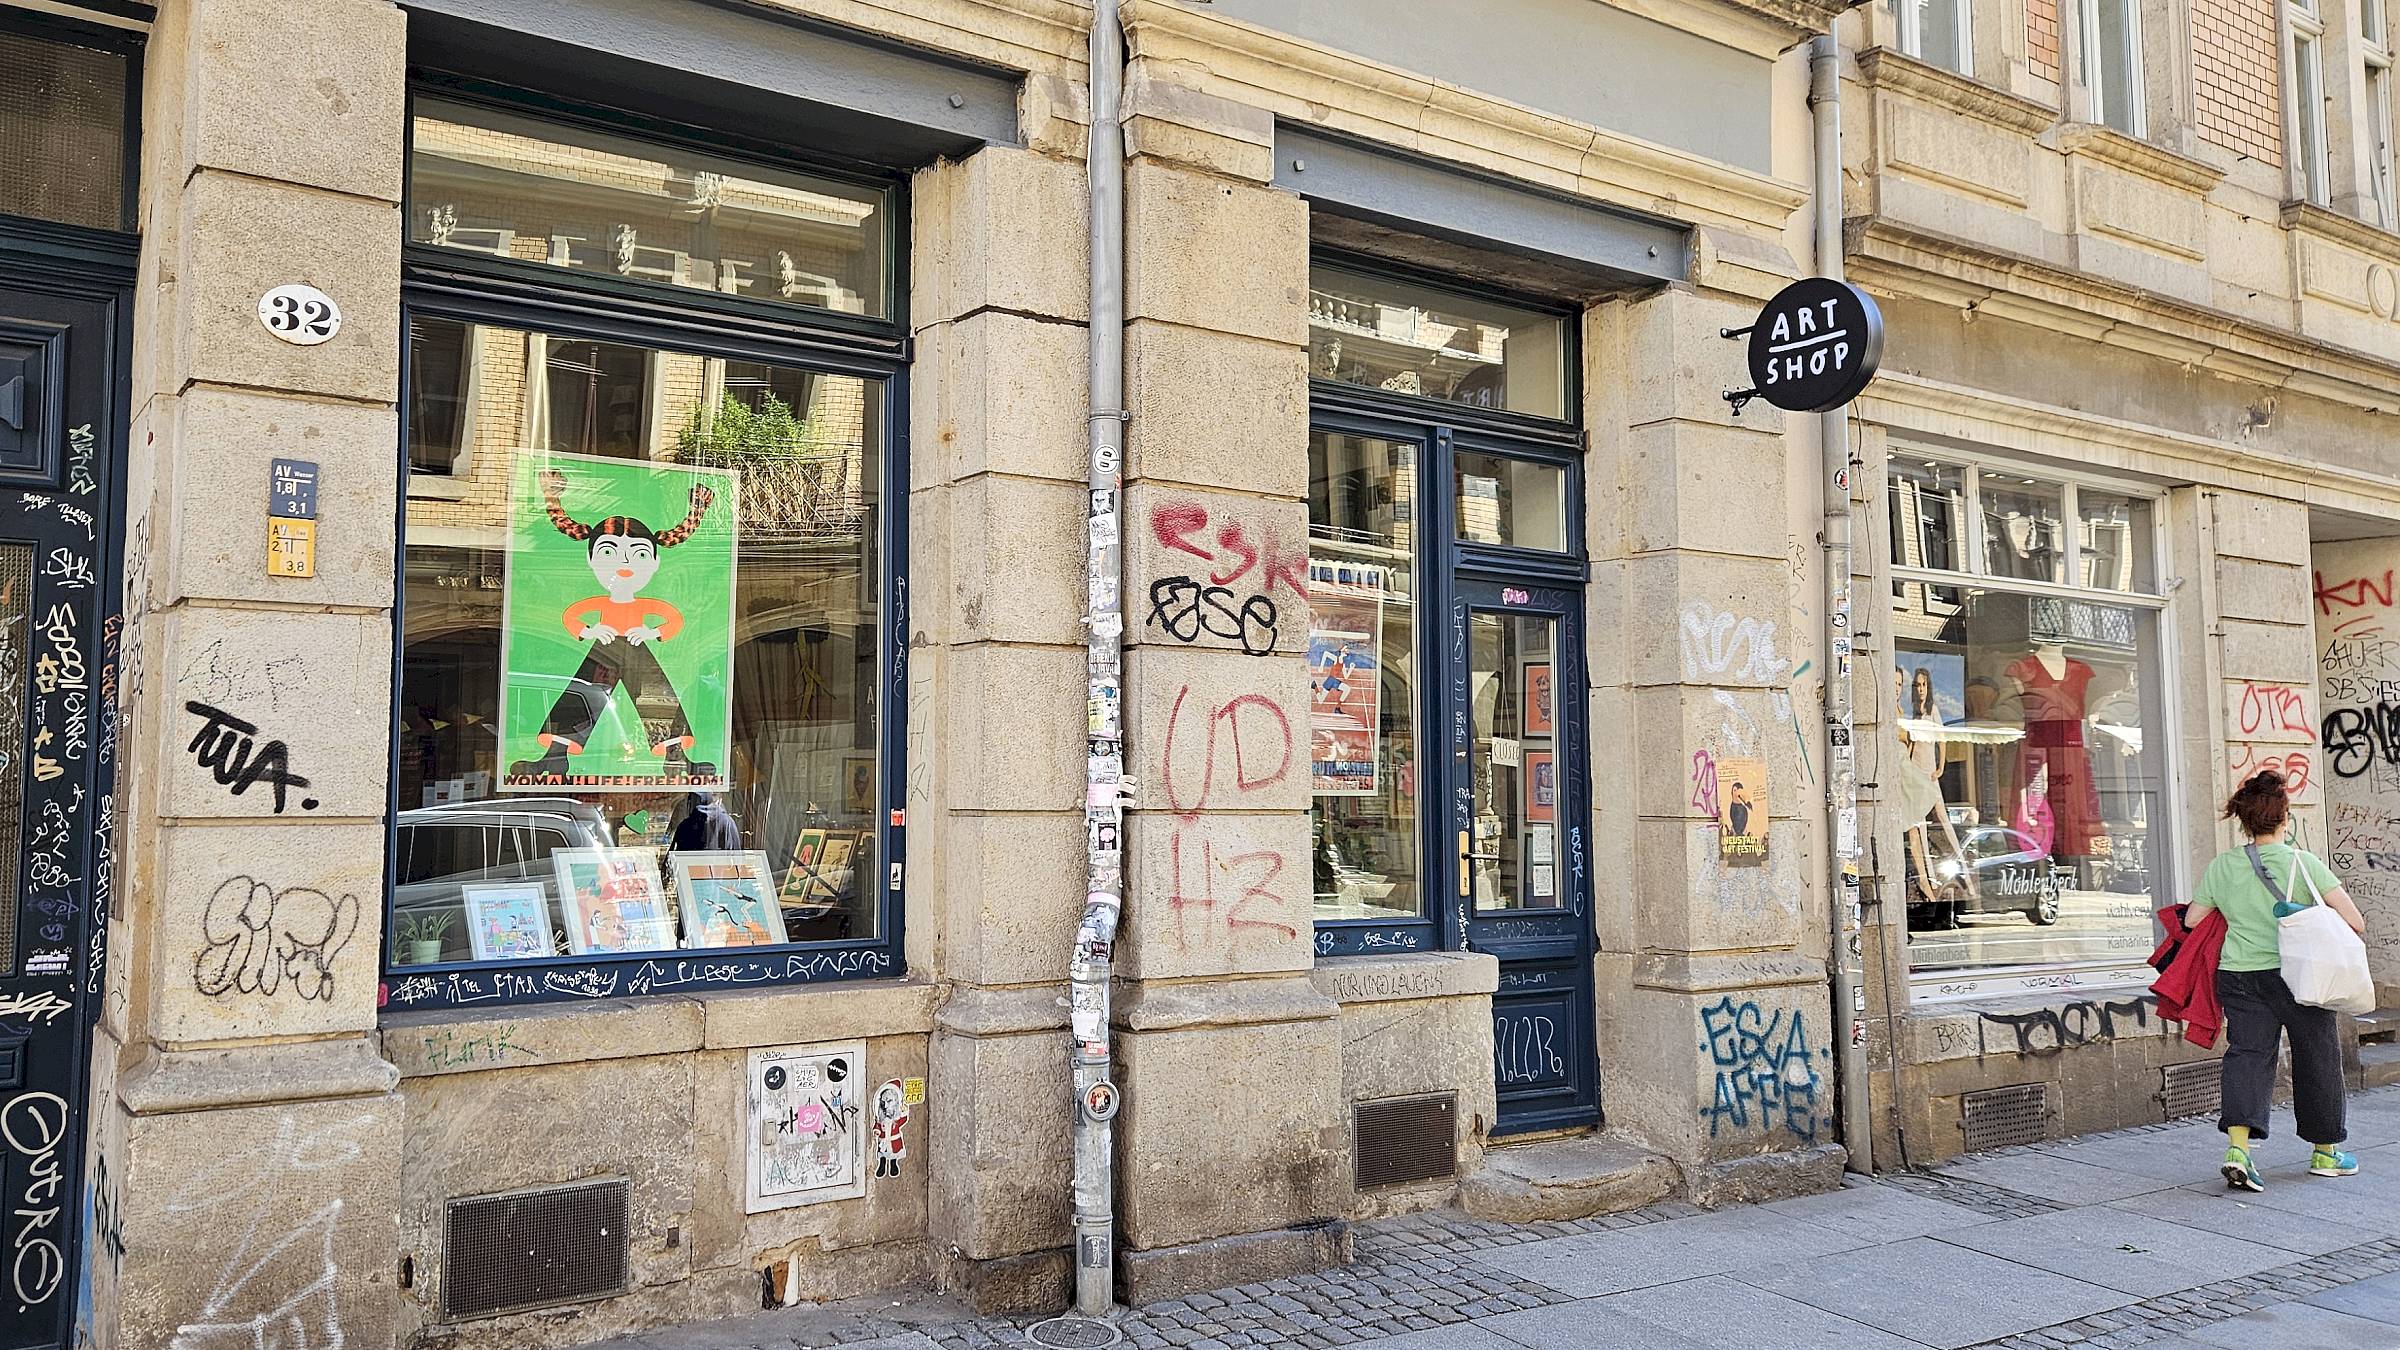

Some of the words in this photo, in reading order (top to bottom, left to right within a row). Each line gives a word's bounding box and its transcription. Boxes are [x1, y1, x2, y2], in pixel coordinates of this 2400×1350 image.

[270, 295, 331, 336] 32
[1771, 299, 1838, 341] ART
[1766, 342, 1849, 385] SHOP
[275, 465, 292, 477] AV
[288, 501, 307, 515] 3,1
[287, 561, 305, 574] 3,8
[1738, 844, 1767, 854] FESTIVAL
